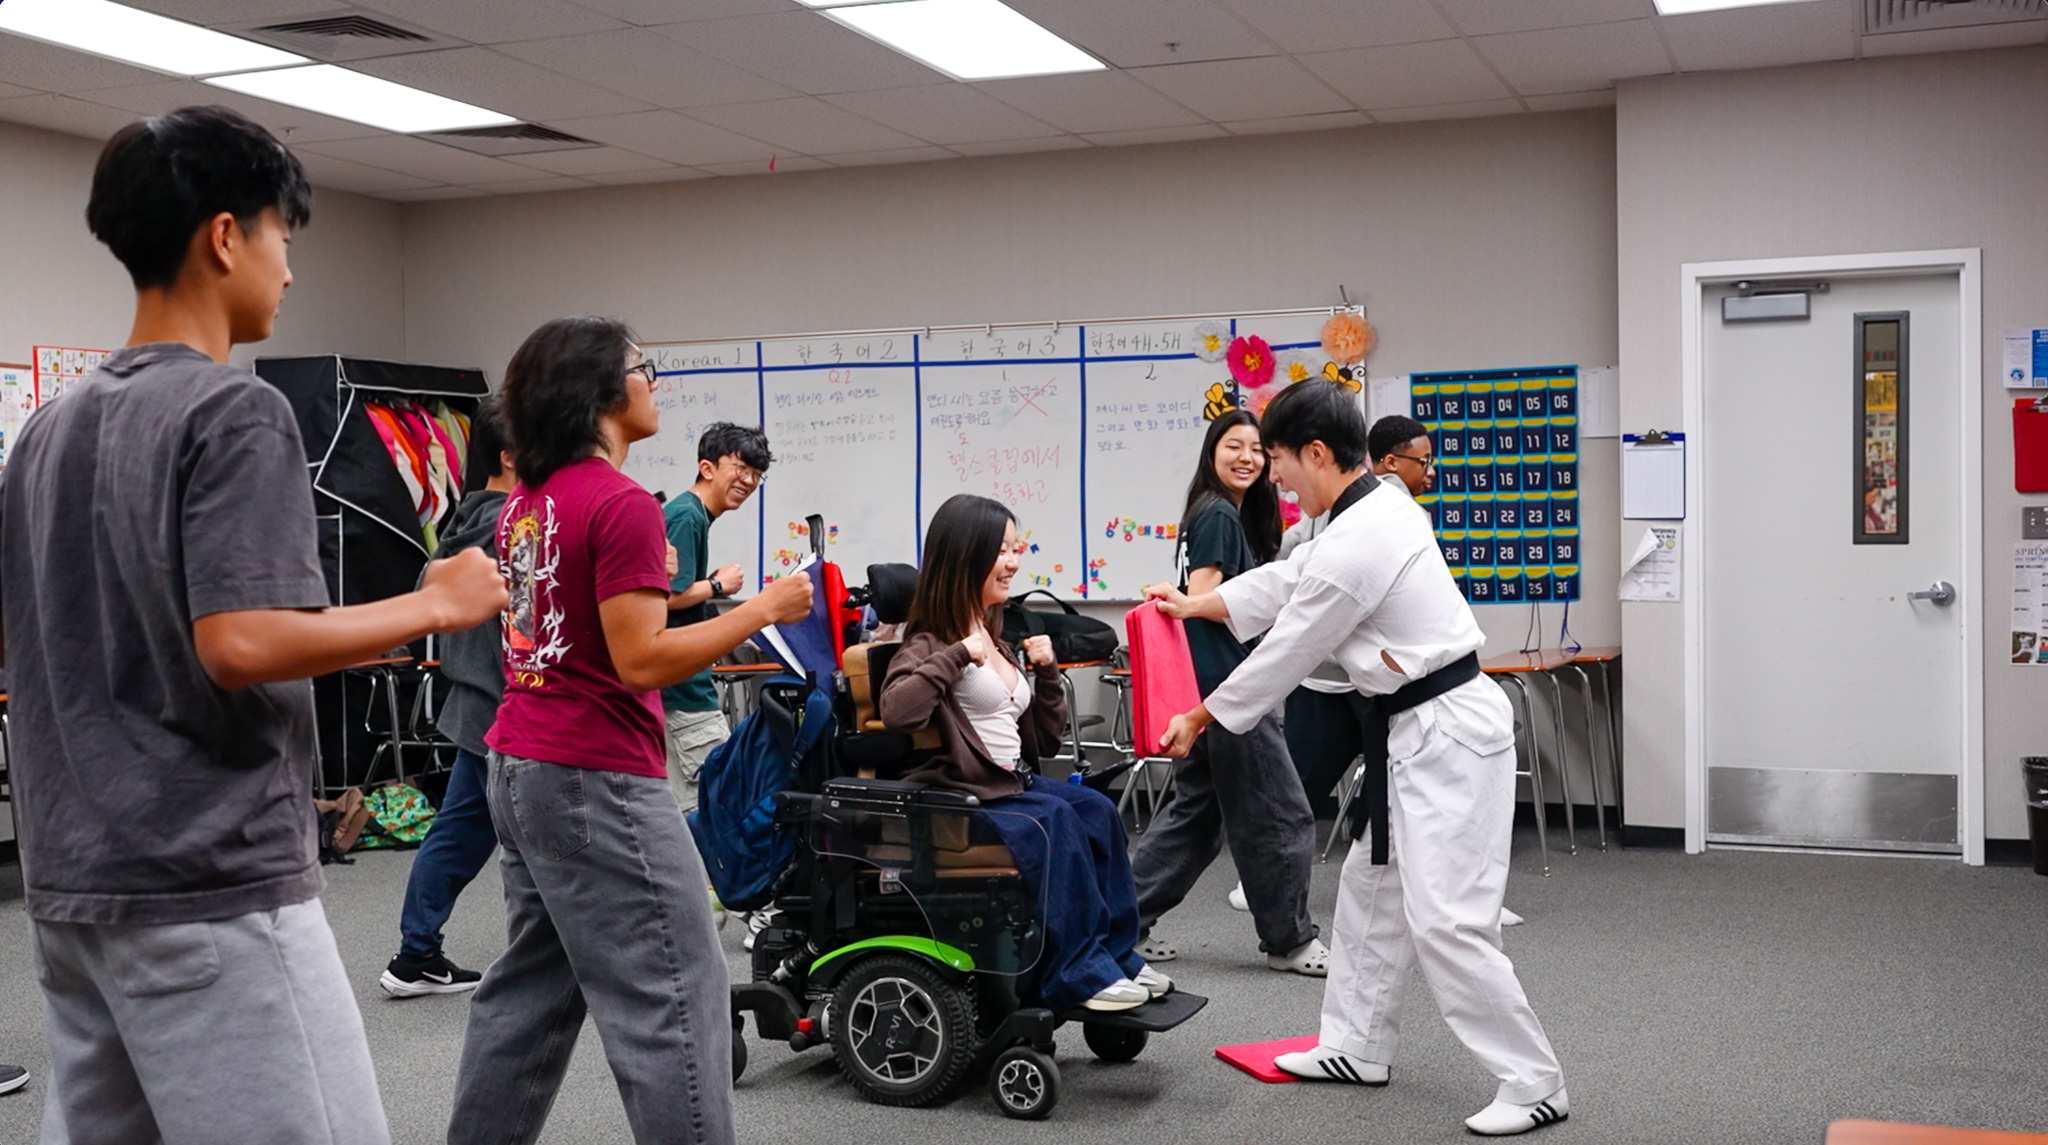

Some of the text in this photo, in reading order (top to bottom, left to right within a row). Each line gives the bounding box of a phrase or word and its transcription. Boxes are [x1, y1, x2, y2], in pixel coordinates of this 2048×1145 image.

[796, 339, 898, 363] 한국어 2
[960, 335, 1056, 360] 한국어 3
[657, 347, 743, 370] Korean 1
[1444, 402, 1459, 415] 02
[1471, 401, 1486, 413] 03
[1498, 399, 1512, 412] 04
[1526, 397, 1541, 410] 05
[1554, 396, 1569, 409] 06
[1417, 403, 1431, 416] 01
[1444, 439, 1458, 451] 08
[1471, 437, 1486, 450] 09
[1499, 437, 1513, 449] 10
[1526, 436, 1540, 448] 11
[1555, 435, 1569, 447] 12
[1445, 474, 1459, 487] 14
[1473, 474, 1487, 487] 15
[1499, 473, 1514, 486] 16
[1527, 472, 1541, 485] 17
[1557, 472, 1571, 484] 18
[1446, 511, 1460, 523] 20
[1474, 511, 1488, 523] 21
[1500, 510, 1515, 523] 22
[1528, 510, 1543, 523] 23
[1556, 510, 1571, 522] 24
[1444, 548, 1460, 561] 26
[1472, 547, 1486, 560] 27
[1499, 547, 1514, 560] 28
[1528, 546, 1543, 560] 29
[1557, 546, 1572, 559] 30
[1473, 583, 1488, 595] 33
[1501, 584, 1515, 595] 34
[1528, 583, 1543, 595] 35
[885, 1015, 902, 1049] ROVI
